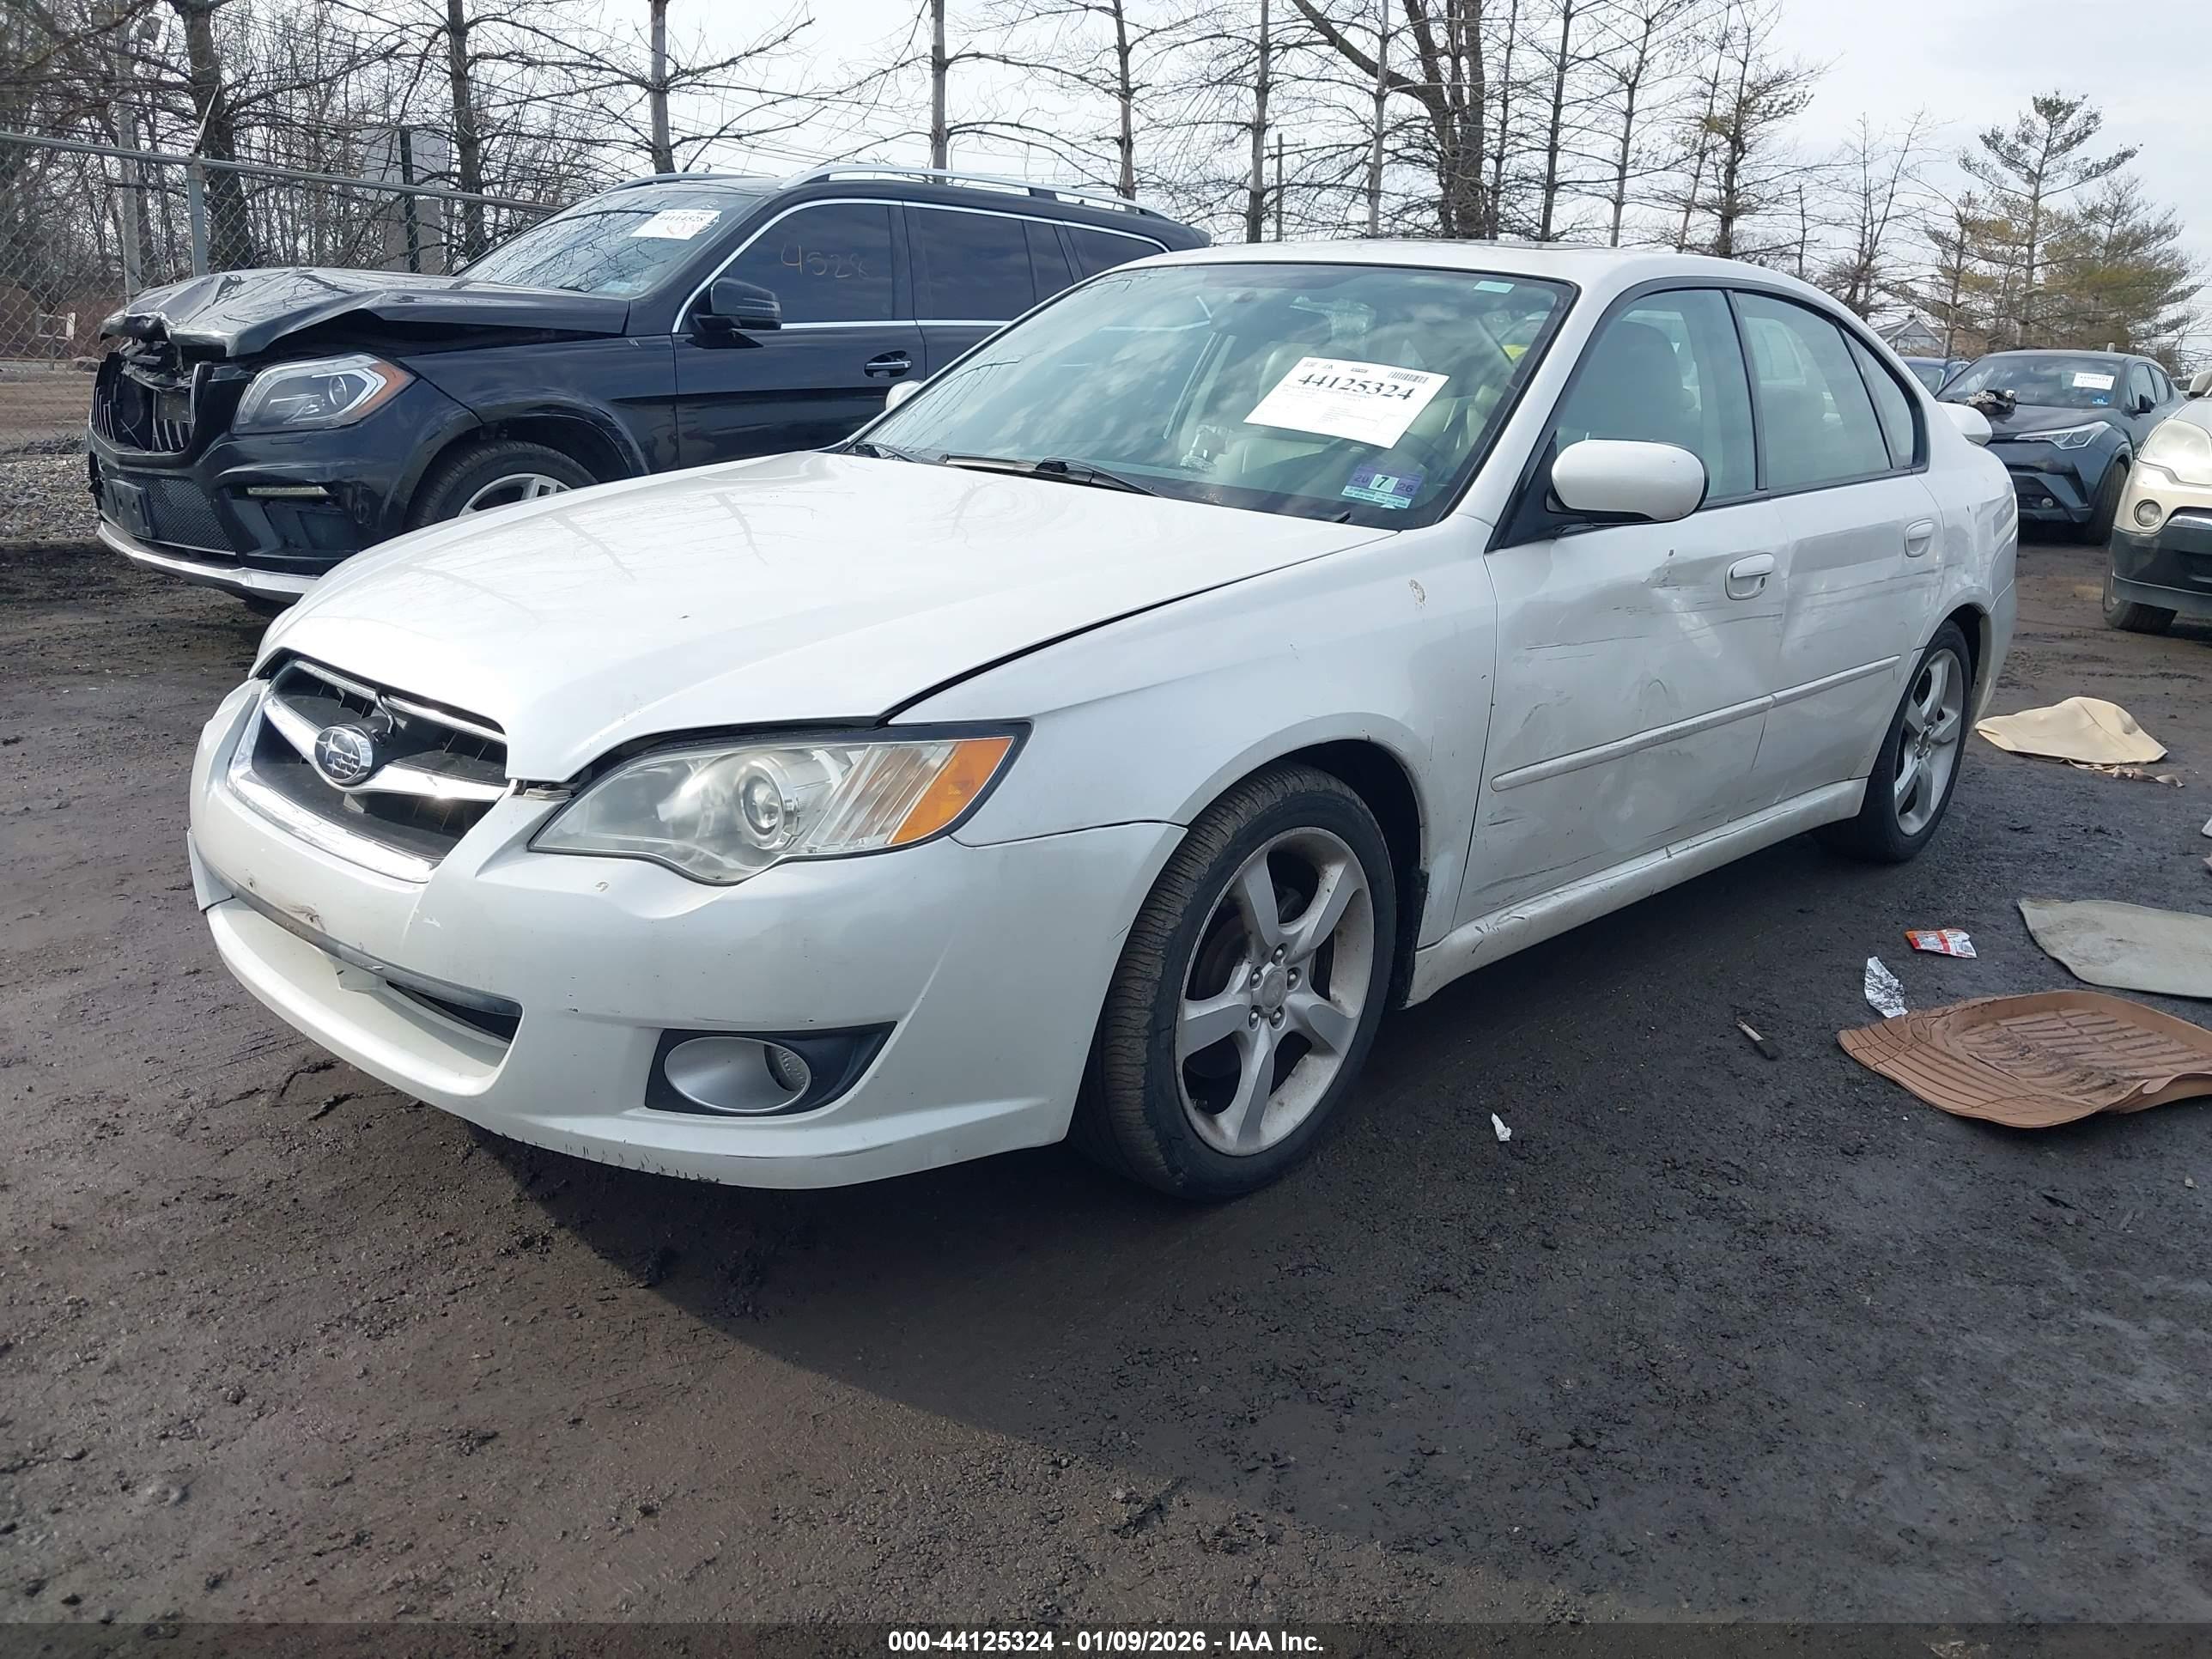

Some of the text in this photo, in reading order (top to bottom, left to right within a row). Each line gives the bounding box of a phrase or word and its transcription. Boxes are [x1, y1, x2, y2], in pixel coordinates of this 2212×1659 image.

[1297, 373, 1416, 400] 44125324
[1376, 476, 1390, 489] 7
[1397, 483, 1413, 493] 26
